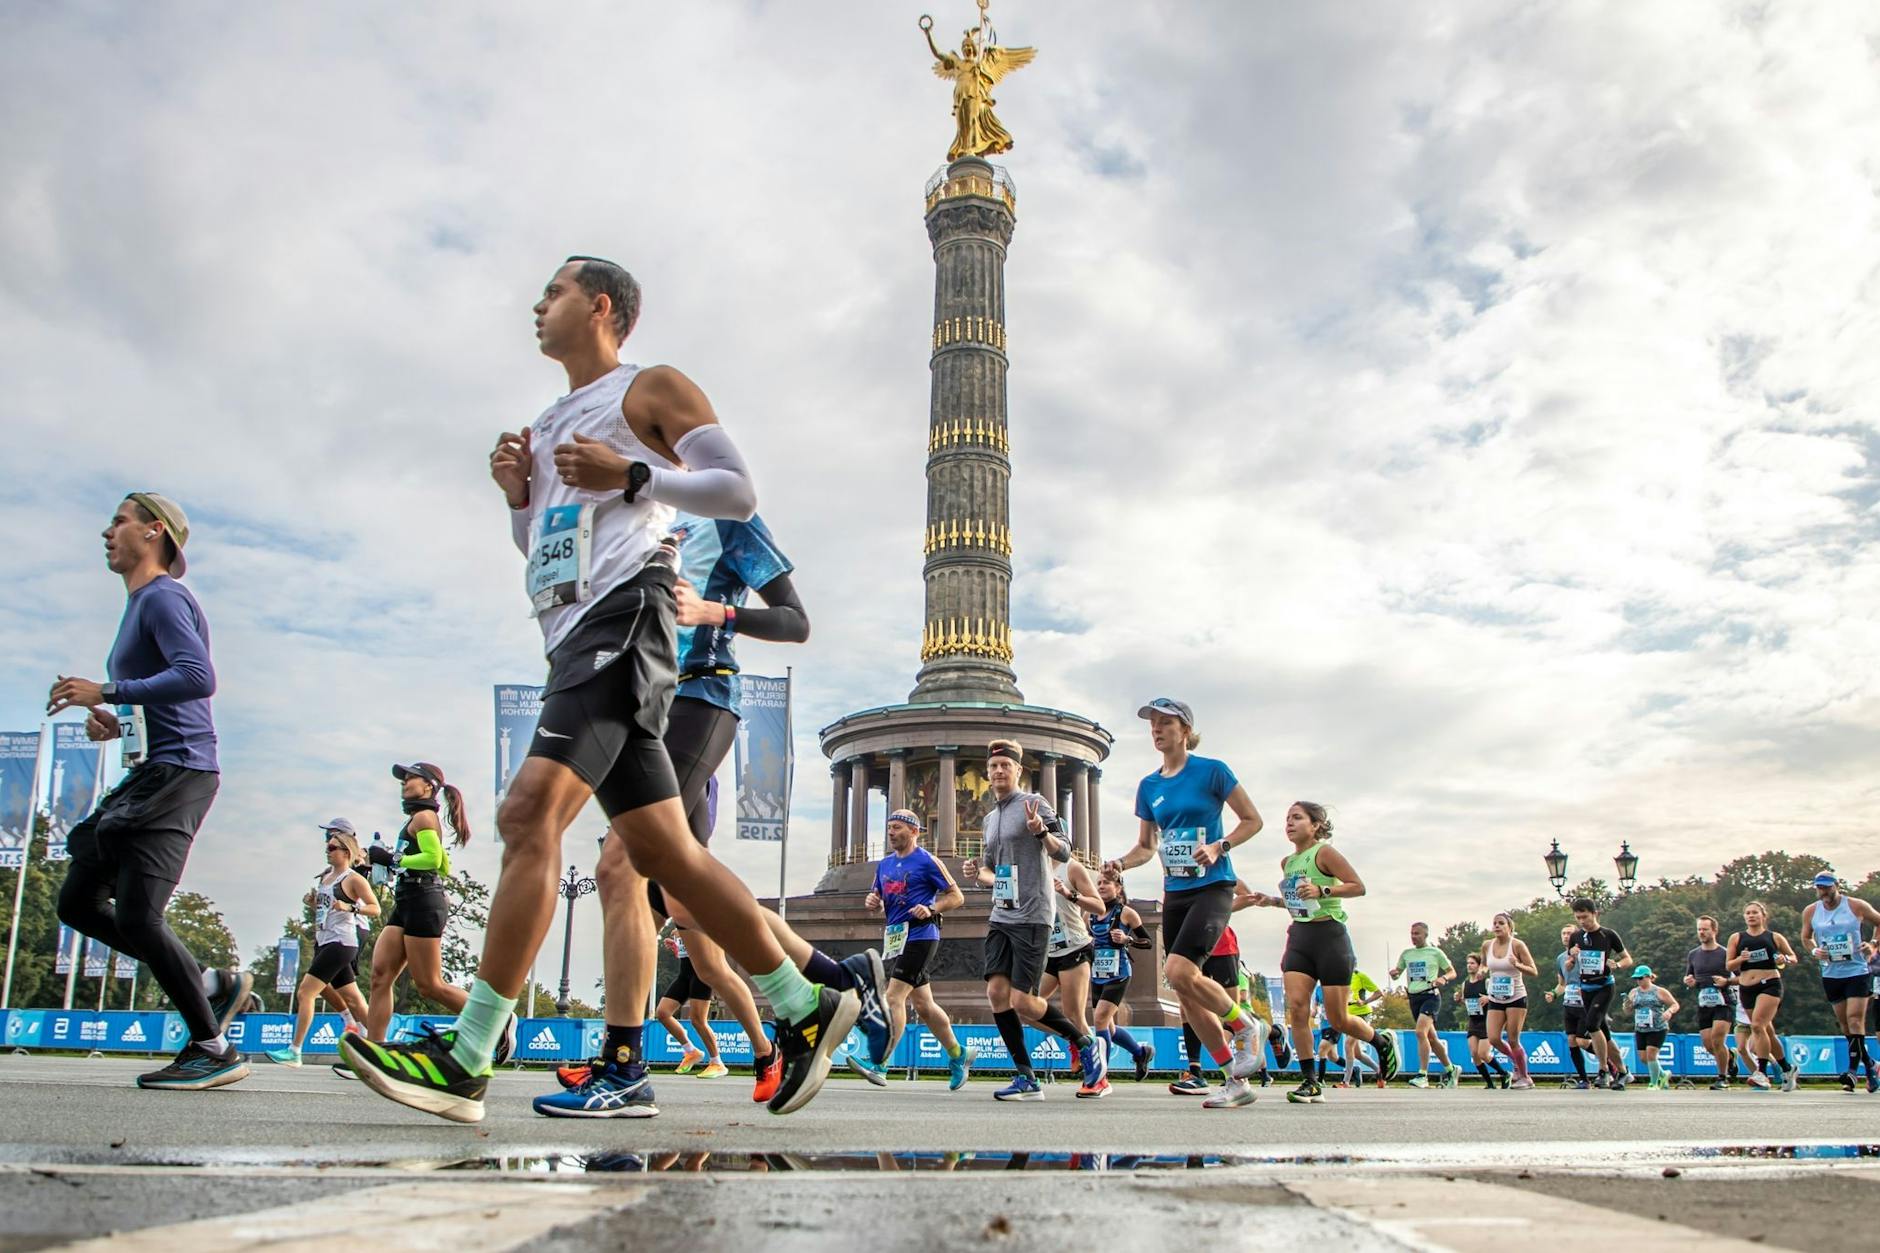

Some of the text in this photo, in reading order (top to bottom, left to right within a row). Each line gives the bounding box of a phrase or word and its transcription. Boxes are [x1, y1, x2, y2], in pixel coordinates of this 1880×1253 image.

[528, 1040, 561, 1050] adidas
[966, 1037, 993, 1047] BMW
[1031, 1050, 1066, 1060] adidas
[1528, 1055, 1560, 1064] adidas
